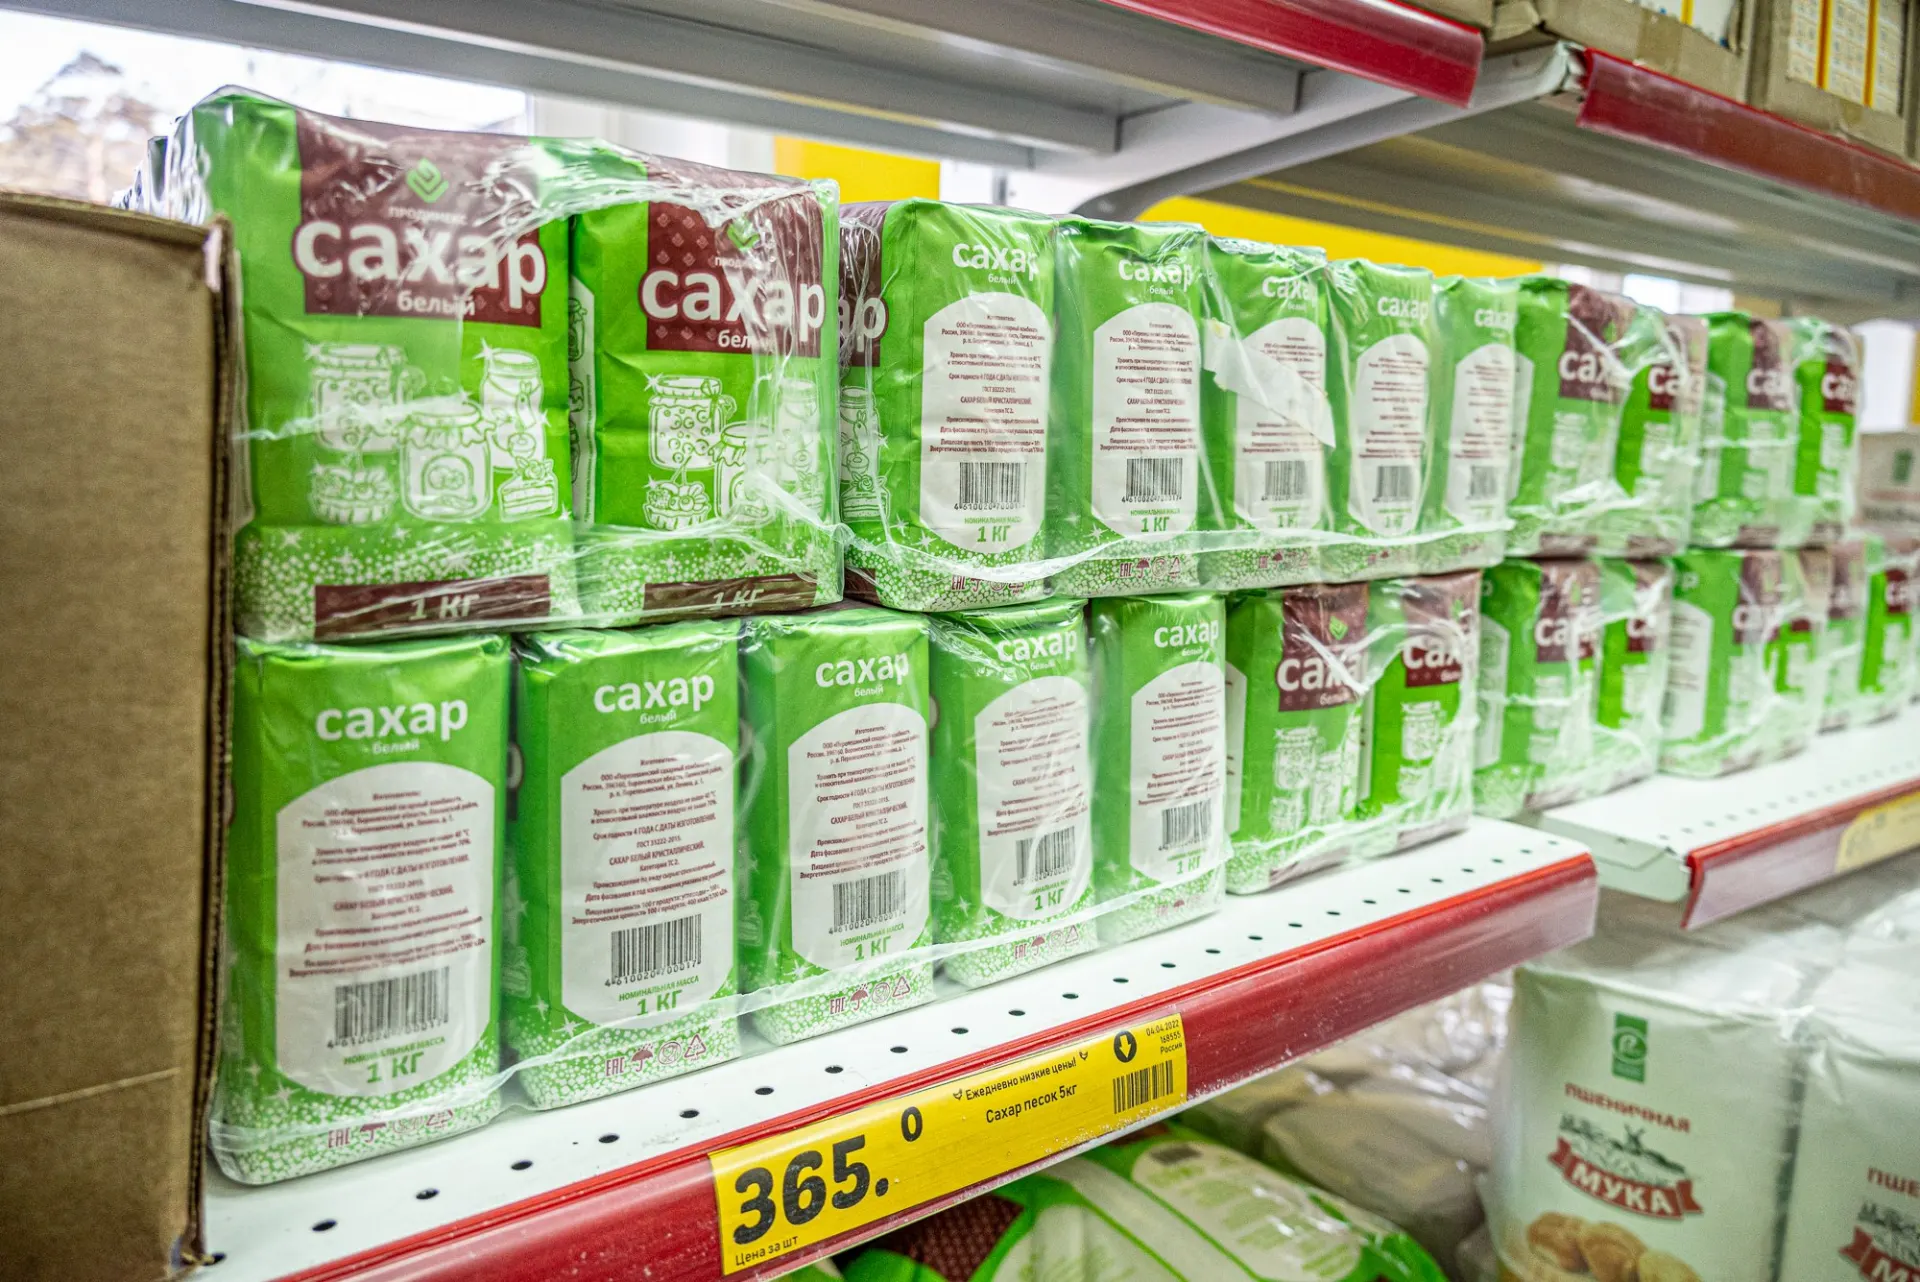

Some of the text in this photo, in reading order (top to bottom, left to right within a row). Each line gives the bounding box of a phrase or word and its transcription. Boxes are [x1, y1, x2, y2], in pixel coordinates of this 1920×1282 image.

[296, 220, 546, 309] сахар
[952, 243, 1038, 281] сахар
[988, 272, 1017, 285] белый
[397, 290, 475, 316] белый
[642, 270, 825, 342] сахар
[977, 525, 1011, 542] 1 КГ
[1141, 516, 1170, 532] 1 КГ
[409, 594, 480, 620] 1 КГ
[998, 630, 1077, 661] сахар
[1154, 619, 1219, 648] сахар
[815, 652, 909, 688] сахар
[593, 674, 715, 714] сахар
[854, 684, 884, 697] белый
[316, 699, 468, 742] сахар
[640, 710, 677, 725] белый
[1035, 888, 1064, 910] 1 КГ
[855, 936, 891, 961] 1 КГ
[619, 975, 700, 1001] НОМИНАЛЬНАЯ МАССА
[637, 989, 683, 1016] 1 КГ
[1146, 1020, 1179, 1036] 04.04.2022
[1160, 1031, 1181, 1044] 168555
[1160, 1042, 1182, 1054] Россия
[367, 1051, 424, 1083] 1 КГ
[966, 1057, 1077, 1101] Ежедневно низкие цены!
[986, 1083, 1078, 1123] Сахар песок 5кг
[1564, 1082, 1690, 1132] ПШЕНИЧНАЯ
[733, 1106, 923, 1245] 365. 0
[1573, 1163, 1674, 1216] МУКА
[735, 1236, 799, 1266] Цена за шт
